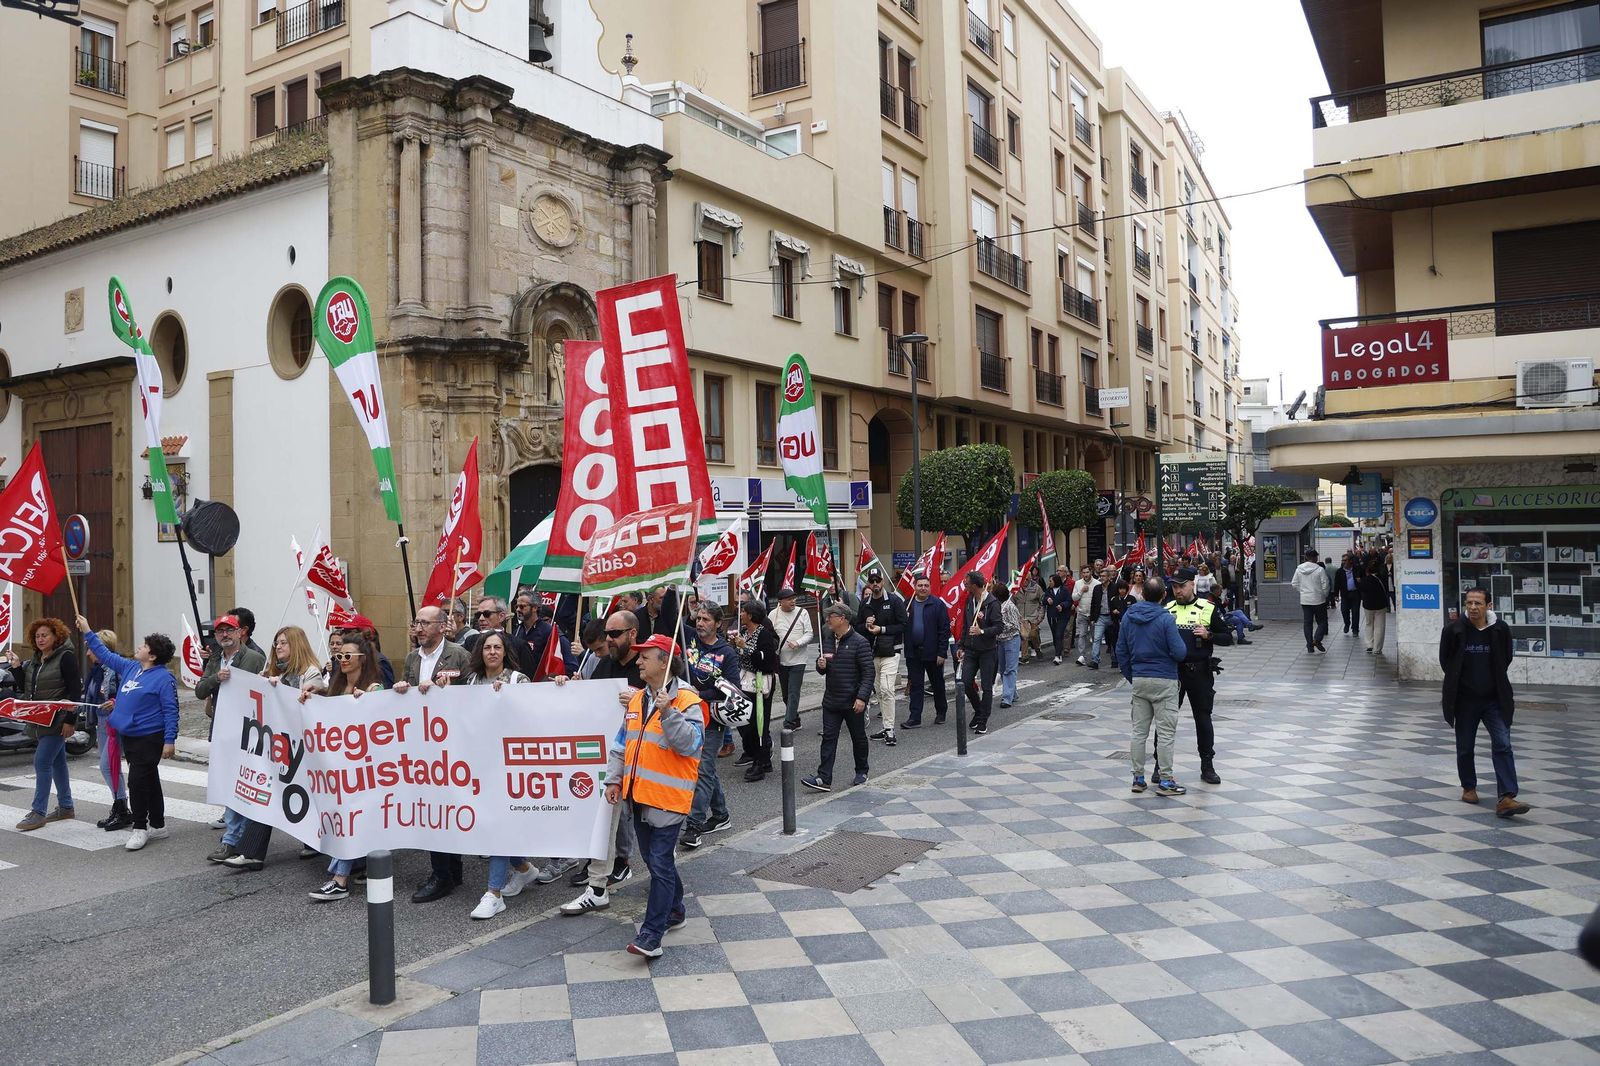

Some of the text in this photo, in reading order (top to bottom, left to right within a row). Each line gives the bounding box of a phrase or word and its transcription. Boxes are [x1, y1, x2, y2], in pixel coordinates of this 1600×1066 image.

[1334, 331, 1433, 361] Legal4
[1331, 363, 1440, 381] ABOGADOS
[615, 290, 692, 511] CCOO
[302, 706, 448, 761] oteger lo
[508, 742, 572, 760] CCOO
[240, 765, 256, 782] UGT
[507, 772, 563, 799] UGT
[381, 793, 477, 832] futuro
